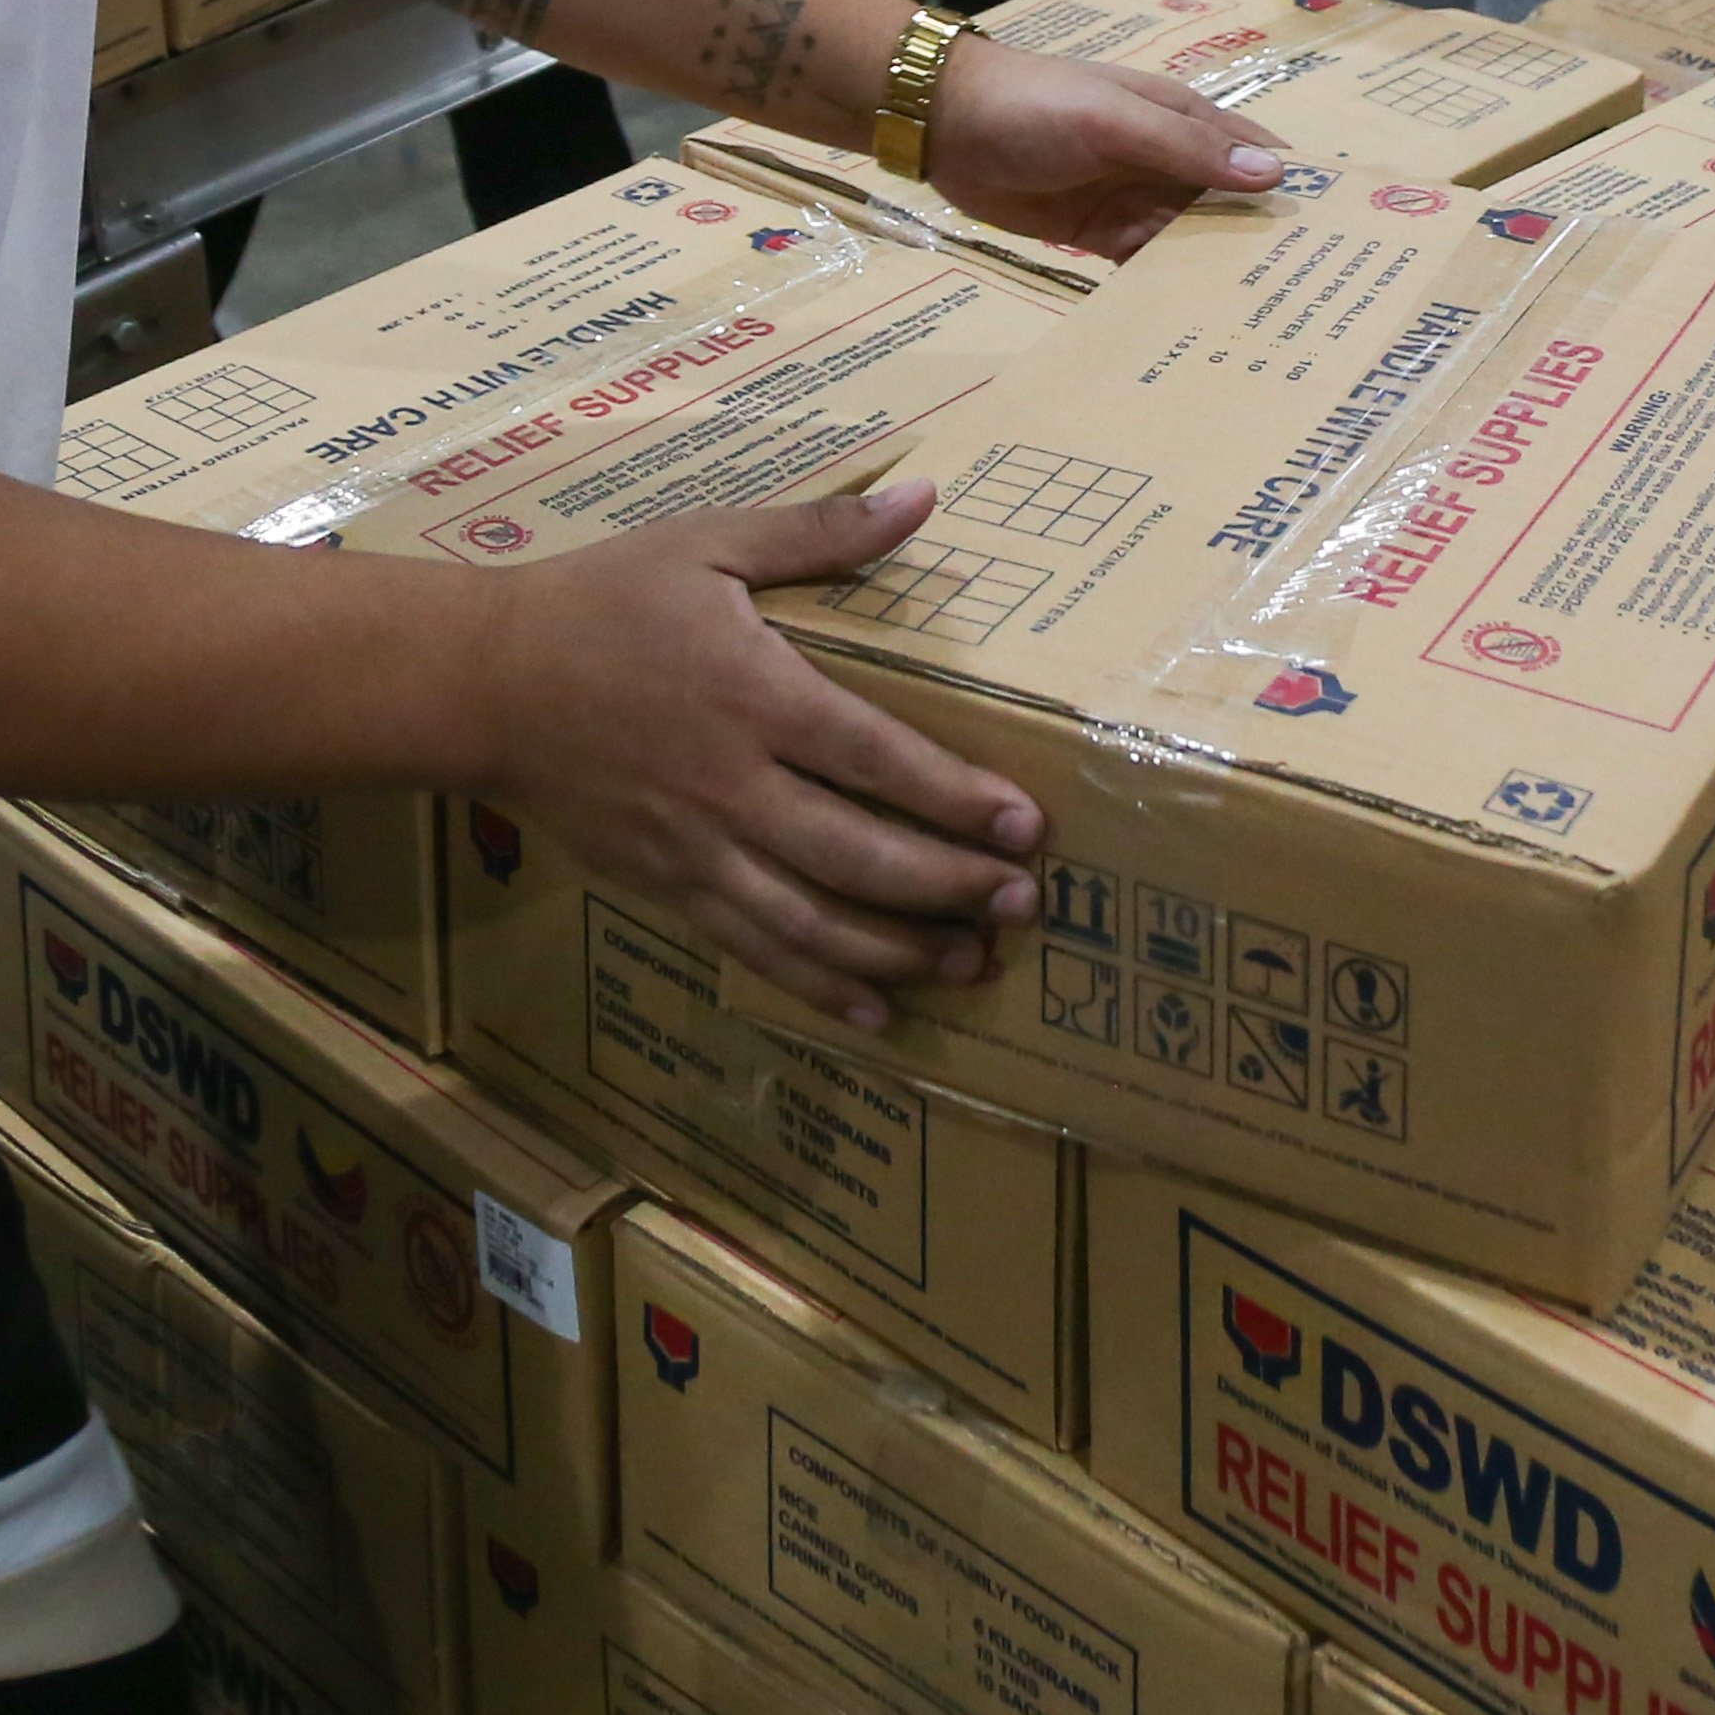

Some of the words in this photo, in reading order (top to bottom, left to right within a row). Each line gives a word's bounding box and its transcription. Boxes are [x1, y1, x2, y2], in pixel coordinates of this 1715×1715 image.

[1265, 226, 1308, 262] PALLET
[1285, 234, 1344, 285] STACKING
[1339, 241, 1380, 276] CASES
[1375, 247, 1418, 285] CASES
[1239, 264, 1270, 286] SIZE
[1314, 278, 1346, 301] PER
[514, 290, 684, 365] HANDLE
[1243, 288, 1291, 328] HEIGHT
[1277, 303, 1322, 339] LAYER
[1325, 295, 1375, 339] PALLET
[1175, 335, 1197, 348] 1.0
[1208, 351, 1228, 362] 10
[1248, 360, 1267, 371] 10
[1349, 299, 1483, 403] HANDLE
[420, 358, 537, 410] WITH
[716, 362, 804, 405] WARNING:
[1138, 361, 1170, 383] 1.2M
[1286, 361, 1312, 380] 100
[400, 410, 585, 497] RELIEF
[557, 314, 785, 420] SUPPLIES
[1609, 390, 1671, 452] WARNING:
[302, 403, 436, 464] CARE
[1287, 395, 1397, 472] WITH
[1337, 483, 1487, 610] RELIEF
[1440, 335, 1610, 489] SUPPLIES
[1205, 466, 1331, 560] CARE
[1089, 503, 1173, 576] PALLETIZING
[1030, 580, 1095, 632] PATTERN
[99, 970, 263, 1145] DSWD
[45, 1032, 160, 1168] RELIEF
[168, 1121, 341, 1306] SUPPLIES
[1321, 1337, 1623, 1595] DSWD
[1217, 1374, 1309, 1445] Department
[1315, 1441, 1331, 1457] of
[1337, 1451, 1387, 1492] Social
[1393, 1484, 1457, 1536] Welfare
[1463, 1530, 1494, 1559] and
[1501, 1550, 1619, 1638] Development
[1217, 1420, 1419, 1606] RELIEF
